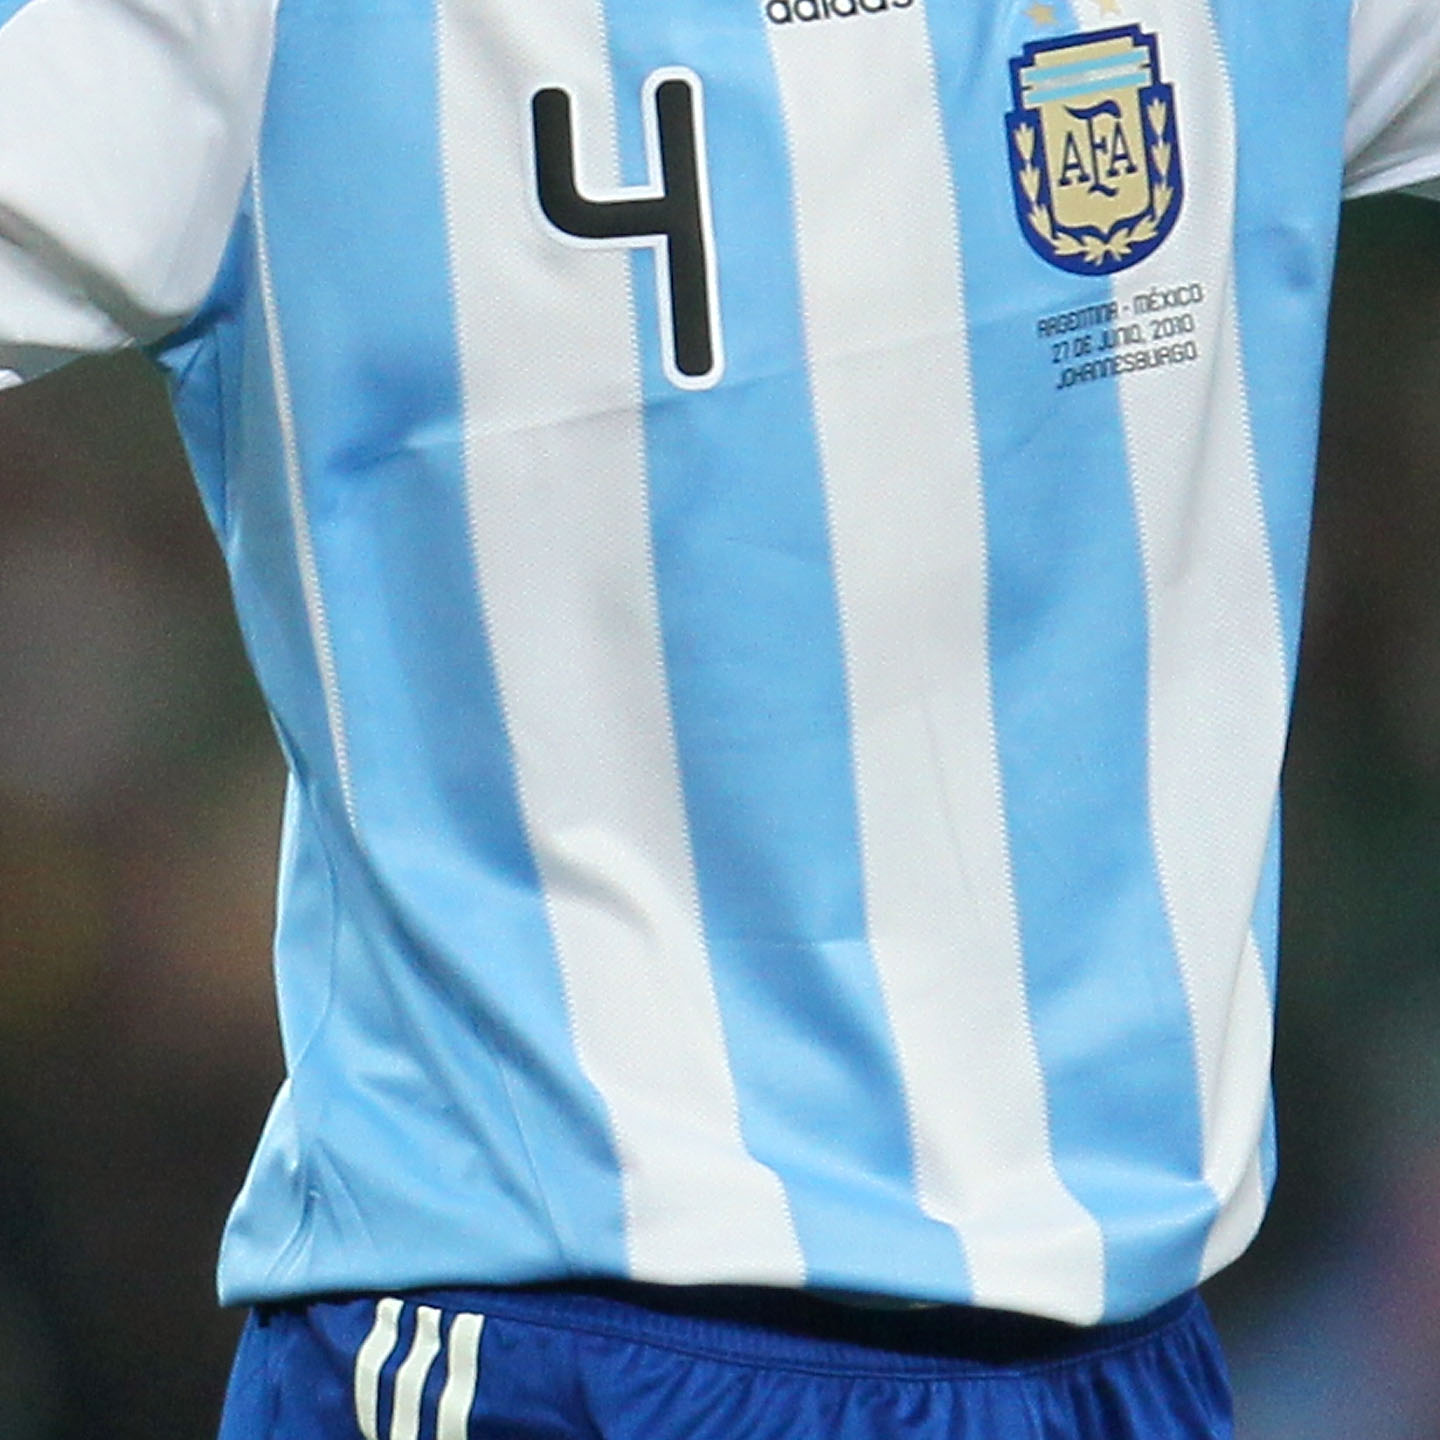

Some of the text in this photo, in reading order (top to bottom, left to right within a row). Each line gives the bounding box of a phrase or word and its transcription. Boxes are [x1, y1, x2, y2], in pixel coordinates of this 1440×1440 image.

[1058, 100, 1138, 197] AFA
[529, 75, 716, 380] 4
[1038, 302, 1118, 338] ARGENTINA
[1134, 284, 1203, 313] MÉXICO
[1052, 341, 1068, 363] 27
[1074, 336, 1091, 358] DE
[1150, 314, 1194, 340] 2010
[1057, 341, 1197, 389] JOHANNESBURGO
